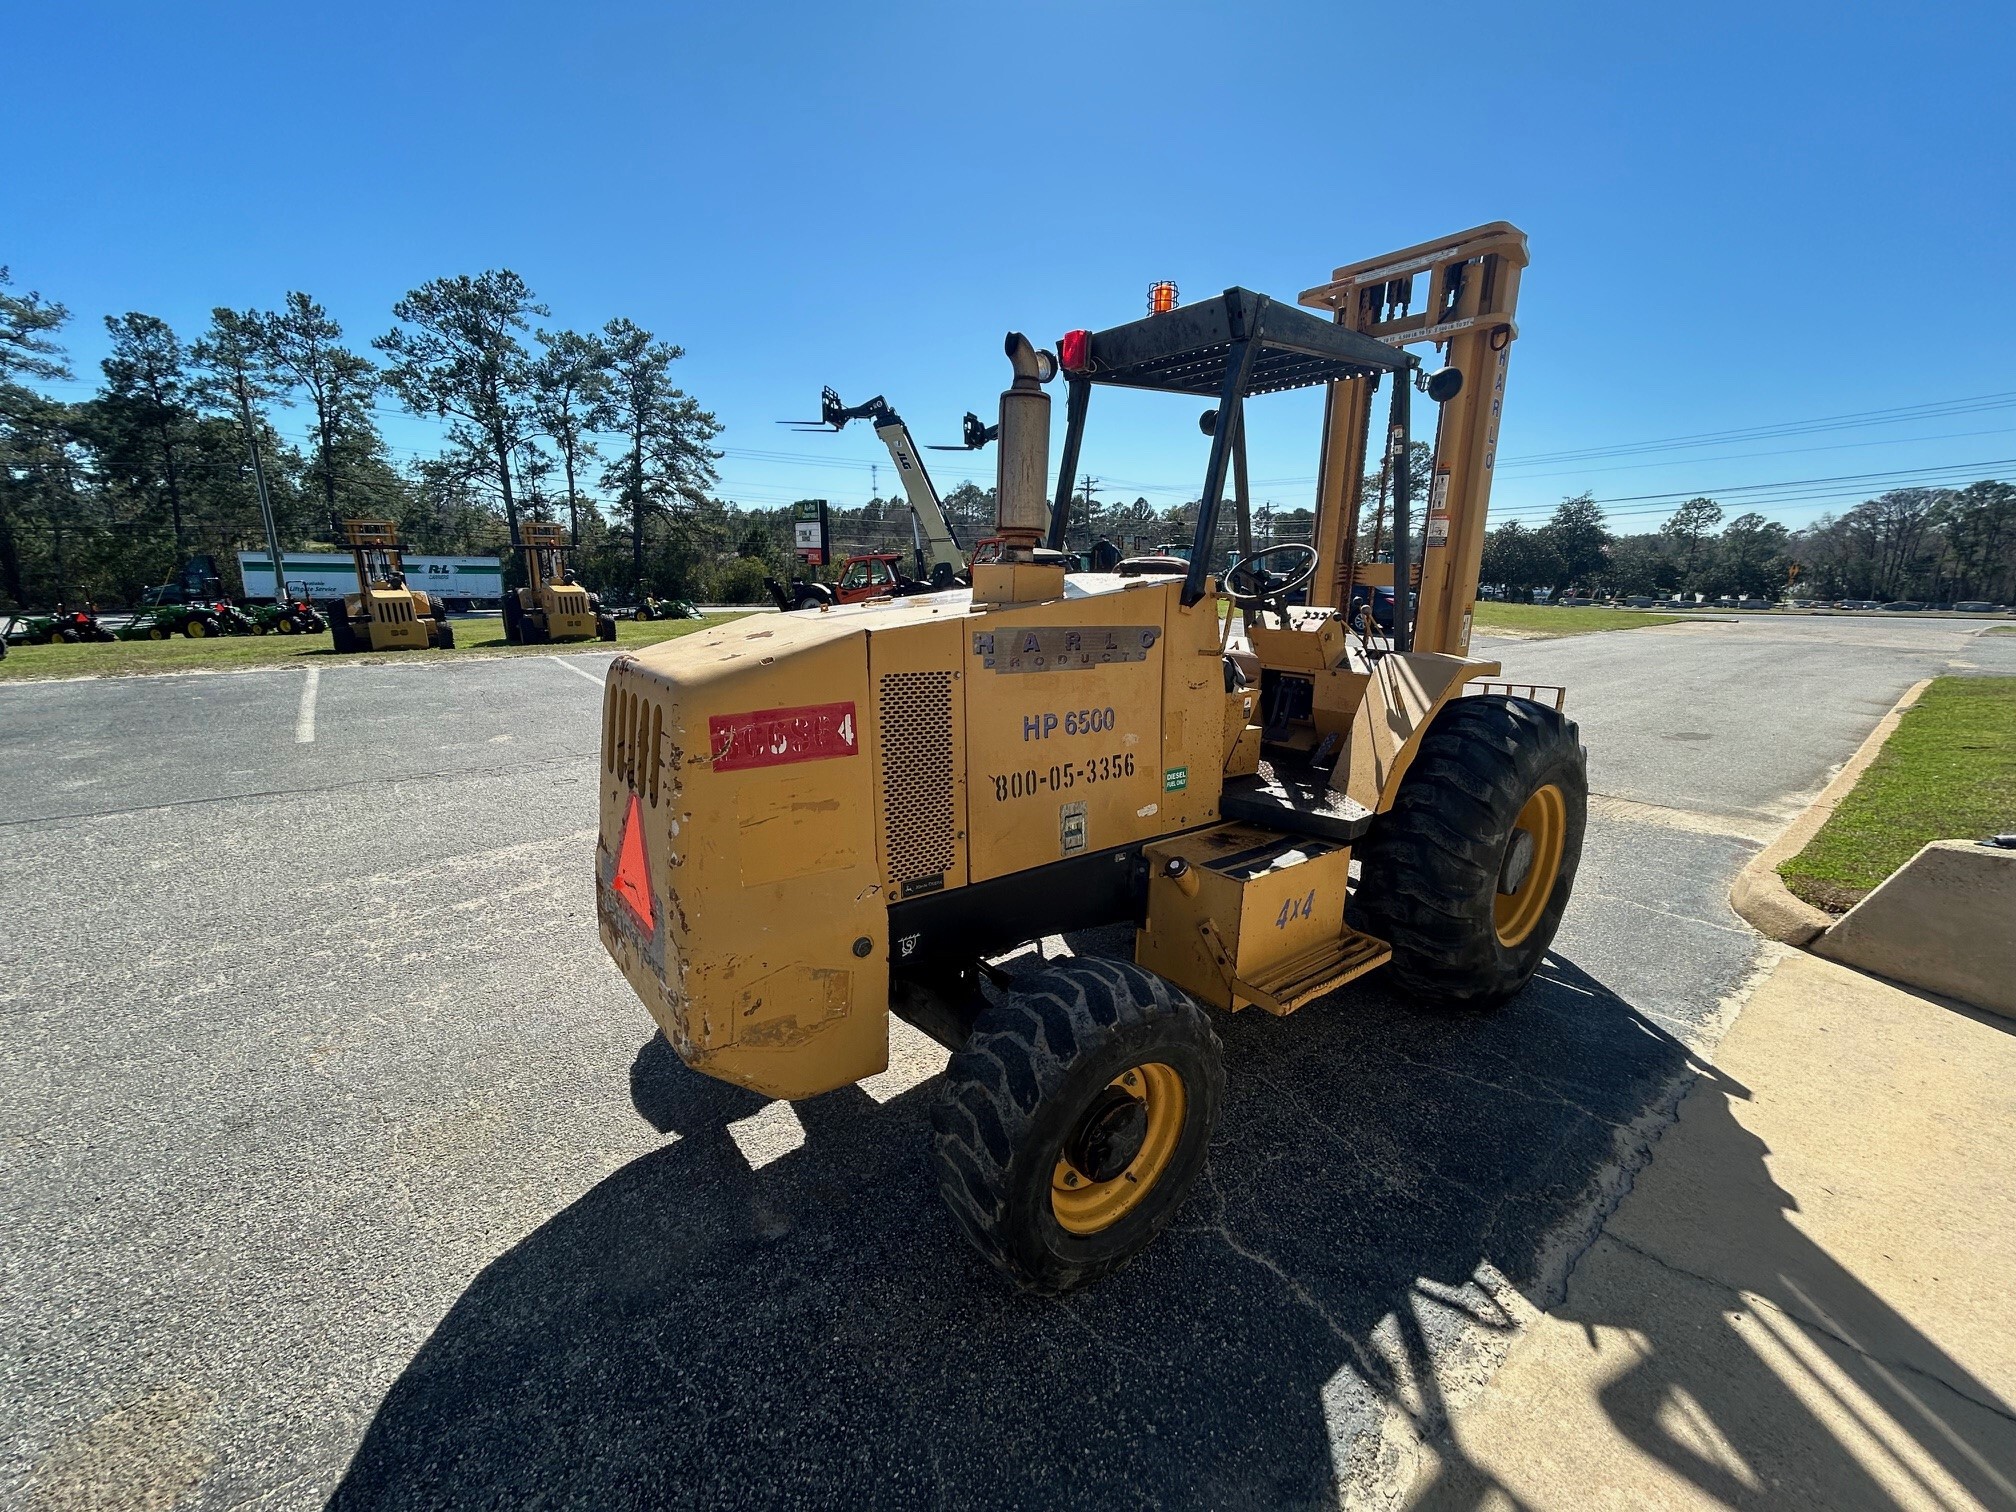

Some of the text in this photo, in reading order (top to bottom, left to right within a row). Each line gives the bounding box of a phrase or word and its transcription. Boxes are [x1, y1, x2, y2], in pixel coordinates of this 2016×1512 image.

[1485, 348, 1507, 470] HARLO
[896, 450, 912, 470] JLG
[974, 630, 1157, 655] HARLO
[984, 652, 1147, 668] PRODUCTS
[1023, 707, 1115, 741] HP 6500
[995, 752, 1135, 802] 800-05-3356
[1166, 771, 1186, 781] DIESEL
